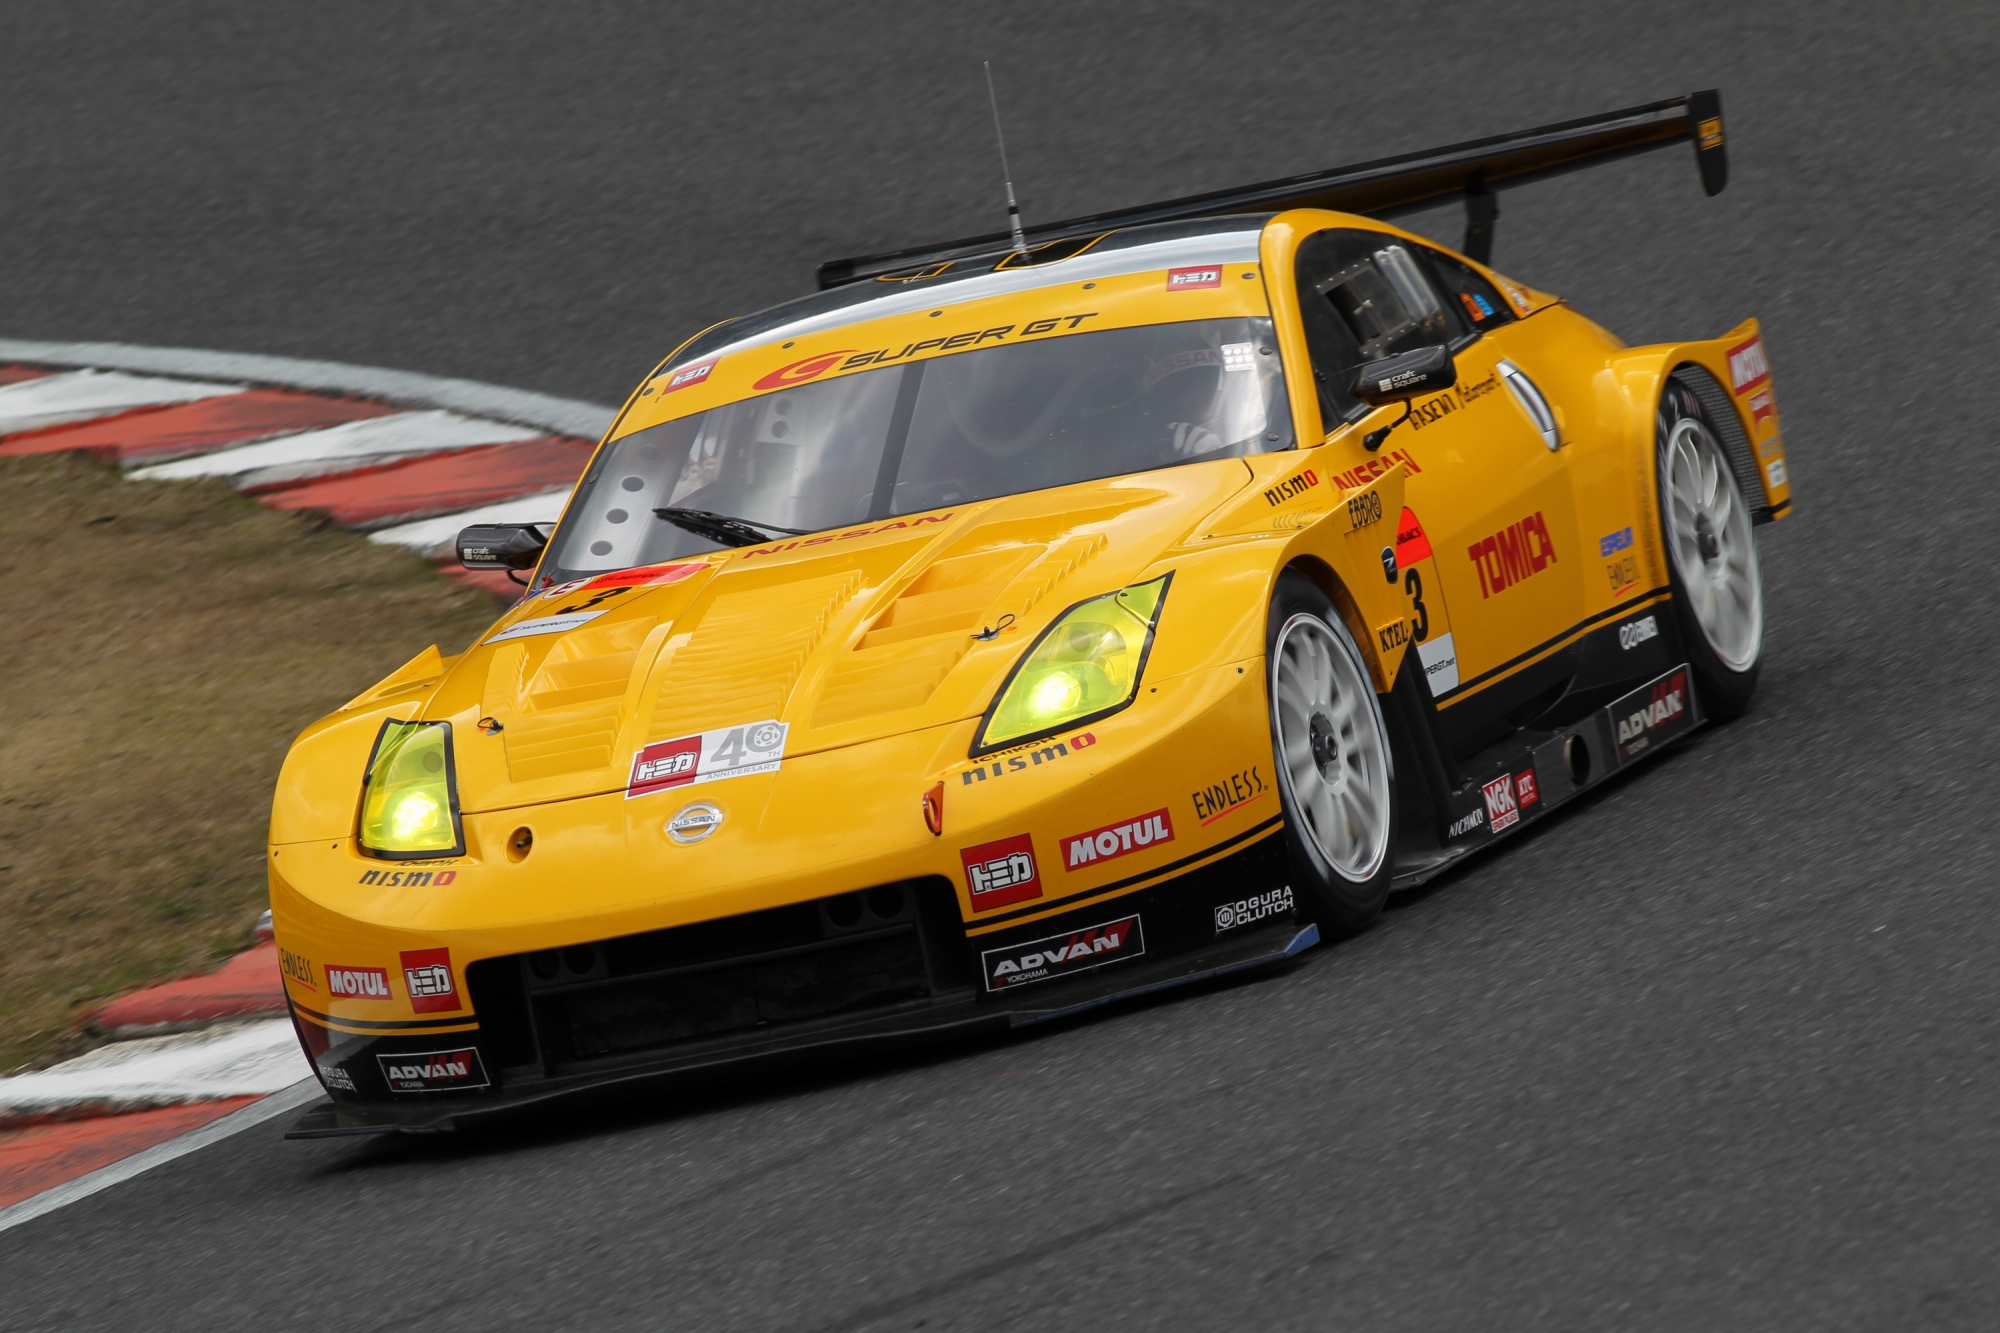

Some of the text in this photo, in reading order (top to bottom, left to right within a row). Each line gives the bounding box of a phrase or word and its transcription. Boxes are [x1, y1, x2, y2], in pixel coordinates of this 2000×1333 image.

[839, 325, 1016, 371] SUPER
[1019, 312, 1099, 337] GT
[741, 513, 955, 560] NISSAN
[1466, 510, 1559, 600] TOMICA
[554, 586, 633, 615] 3
[1404, 567, 1429, 643] 3
[1618, 690, 1684, 745] ADVAN
[635, 751, 698, 783] トミカ
[767, 750, 781, 758] TH
[961, 732, 1097, 786] nismo
[972, 736, 1057, 765] ICHIKOH
[705, 762, 778, 781] ANNIVERSARY
[1191, 766, 1264, 820] ENDLESS
[1484, 776, 1517, 820] NGK
[671, 815, 716, 830] NISSAN
[1068, 814, 1169, 867] MOTUL
[358, 869, 457, 887] nismo
[969, 852, 1035, 895] トミカ
[1235, 885, 1293, 913] OGURA
[1236, 896, 1295, 926] CLUTCH
[993, 932, 1120, 977] ADVAN
[329, 969, 388, 996] MOTUL
[405, 964, 453, 998] トミカ
[1006, 967, 1049, 984] YOKOHAMA
[389, 1061, 468, 1081] ADVAN
